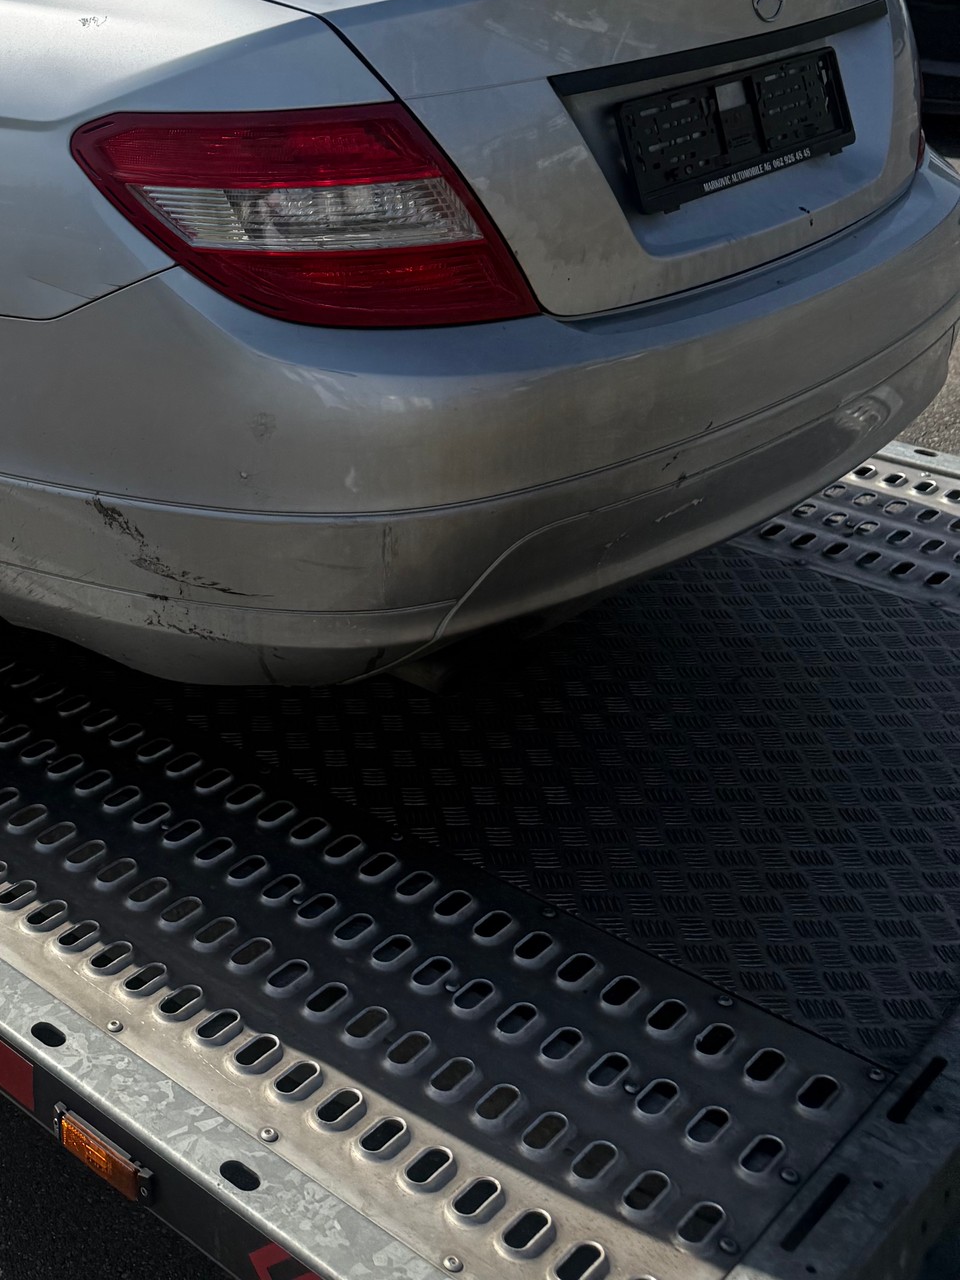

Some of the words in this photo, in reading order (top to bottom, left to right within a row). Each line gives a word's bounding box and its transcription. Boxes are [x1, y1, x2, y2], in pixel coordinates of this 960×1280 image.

[703, 175, 732, 192] MARKOVIC
[731, 164, 764, 183] AUTOMOBILE
[764, 161, 773, 172] AG
[772, 157, 785, 169] 062
[783, 152, 796, 164] 926
